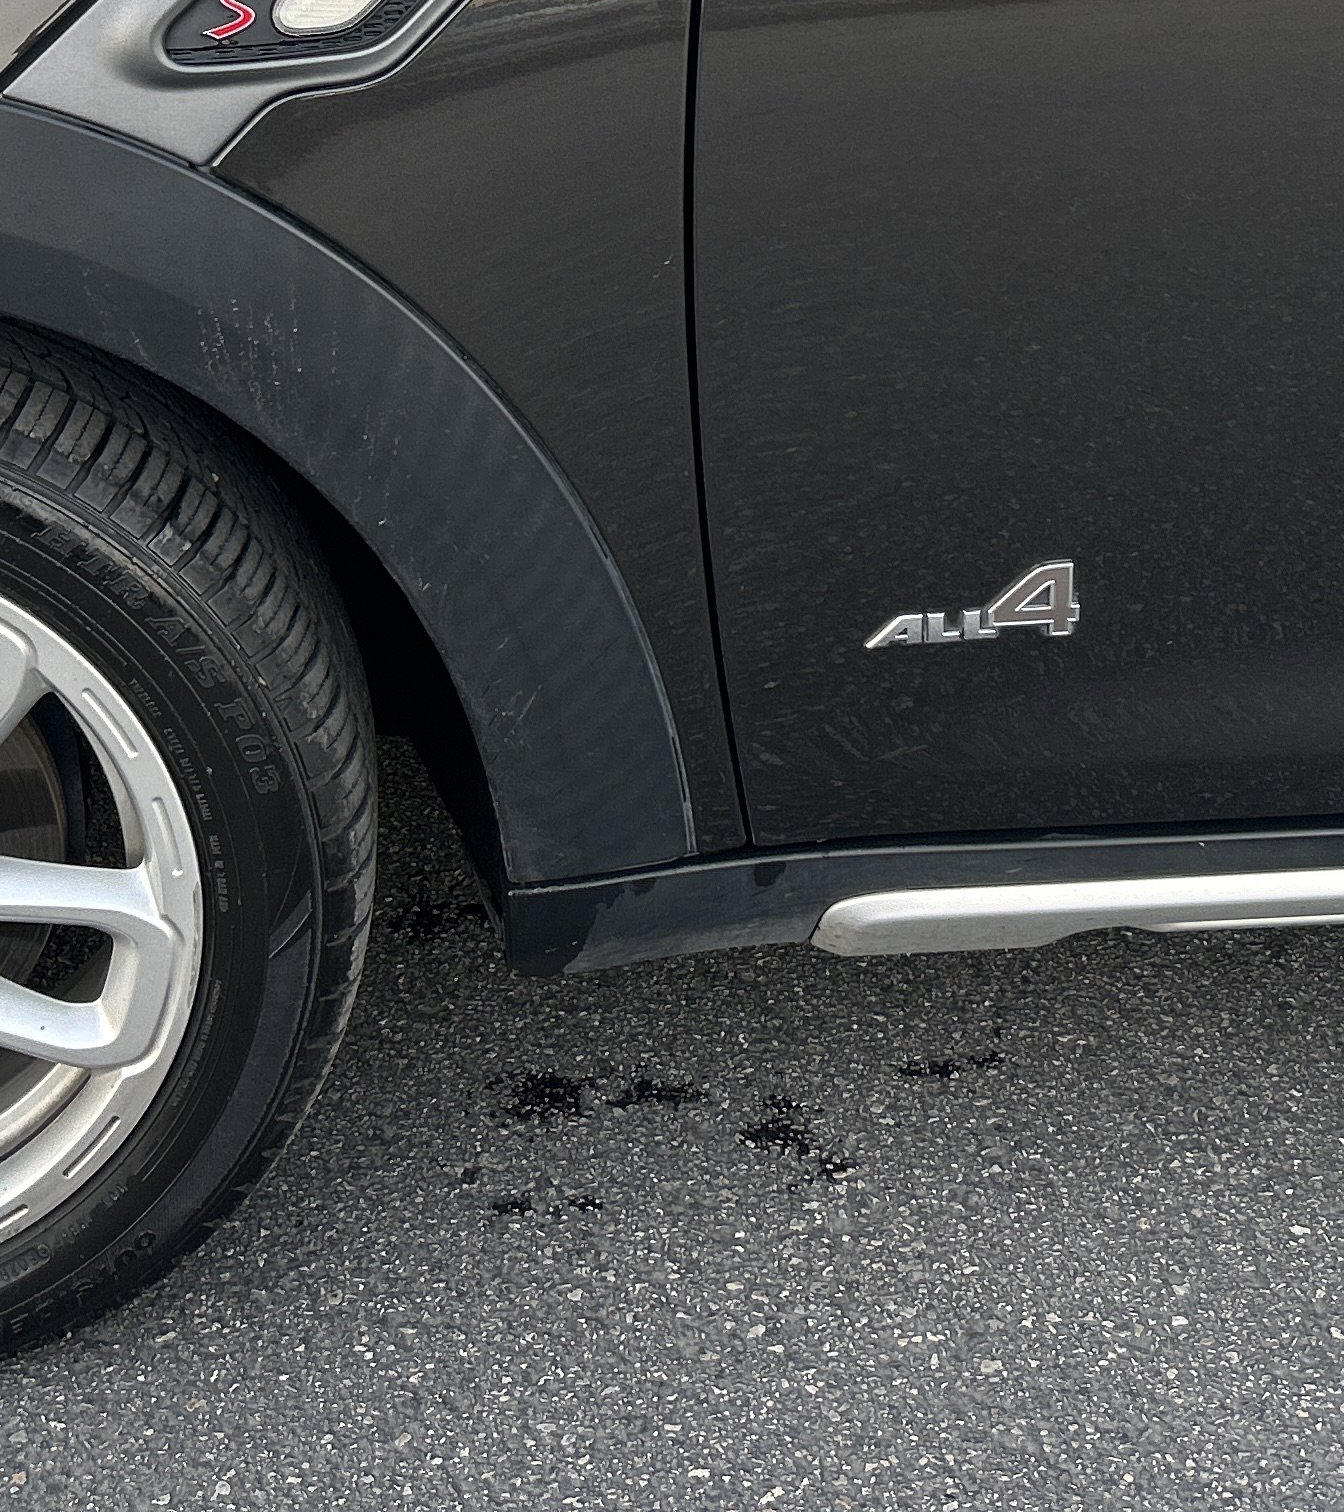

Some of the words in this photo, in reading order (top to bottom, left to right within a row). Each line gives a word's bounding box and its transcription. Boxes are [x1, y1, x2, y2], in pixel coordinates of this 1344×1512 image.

[27, 513, 160, 614] HTR
[142, 601, 232, 692] A/S
[211, 691, 287, 797] P03
